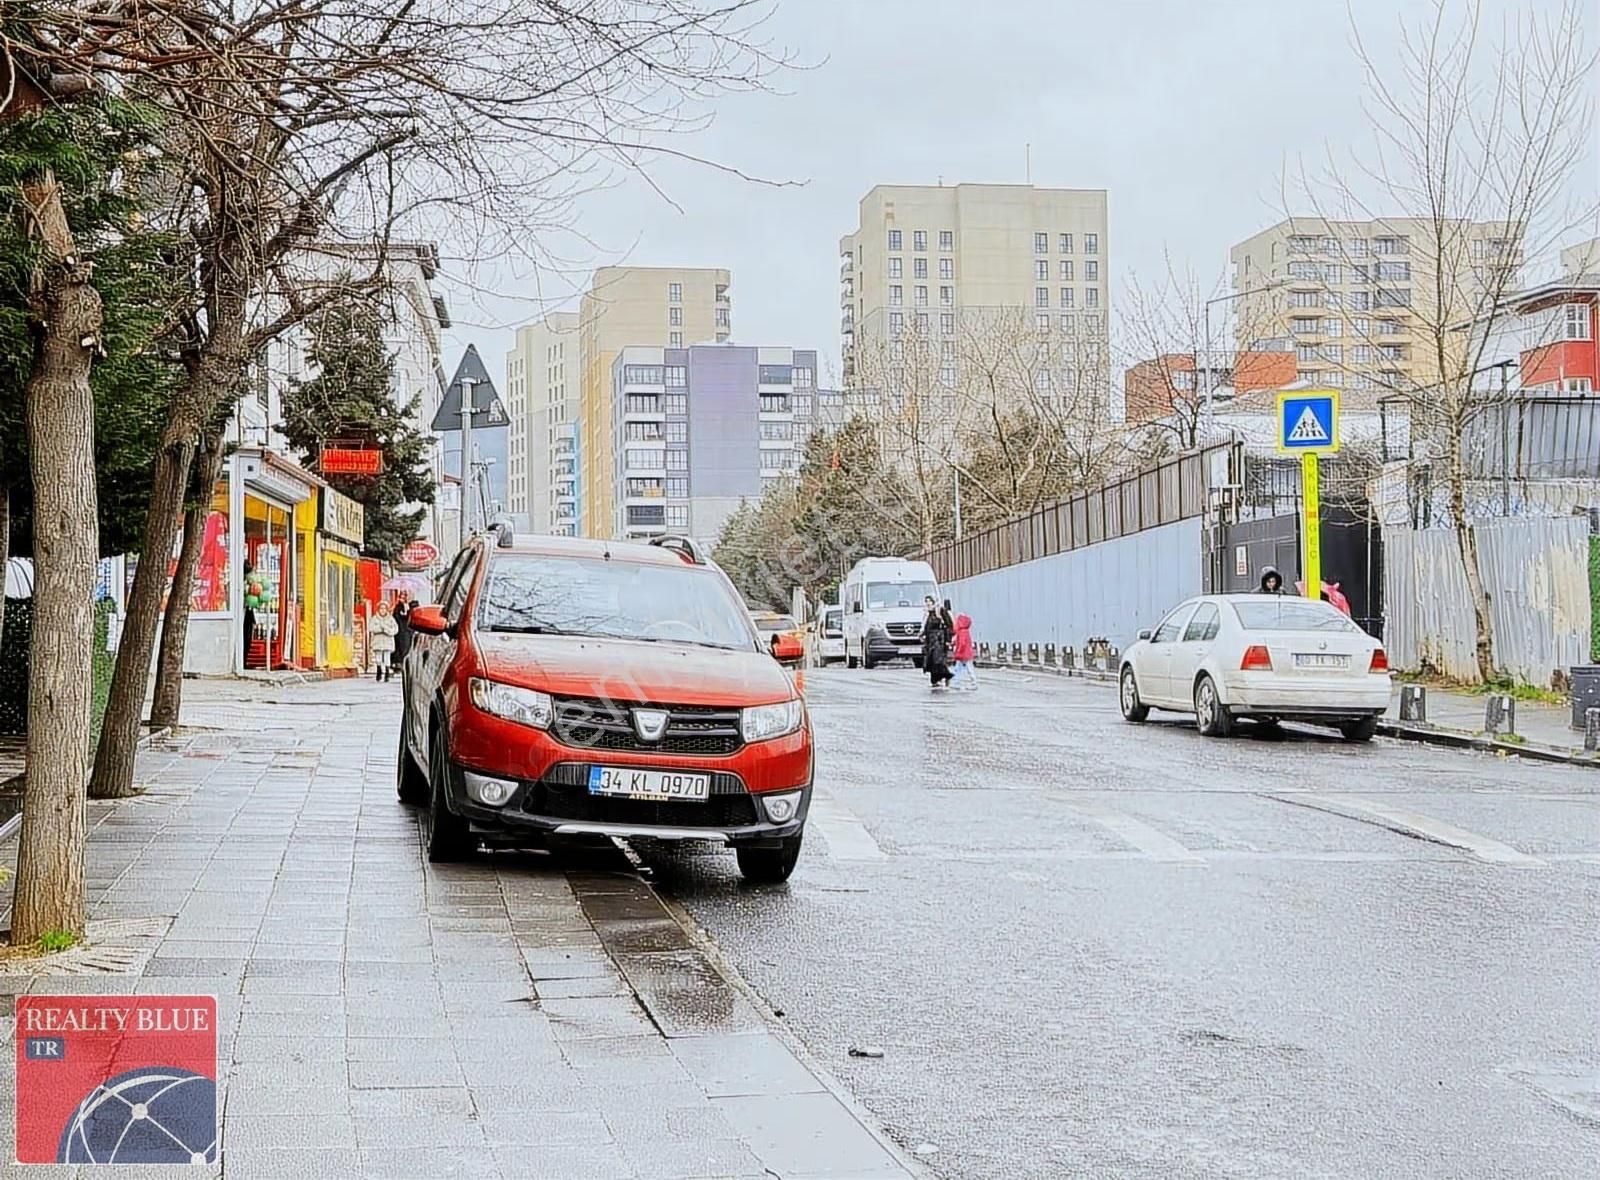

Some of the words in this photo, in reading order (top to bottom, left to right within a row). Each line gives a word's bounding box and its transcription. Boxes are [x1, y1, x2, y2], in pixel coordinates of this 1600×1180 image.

[1307, 459, 1316, 507] OKUL
[601, 771, 621, 790] 34
[630, 773, 651, 792] KL
[660, 775, 705, 796] 0970
